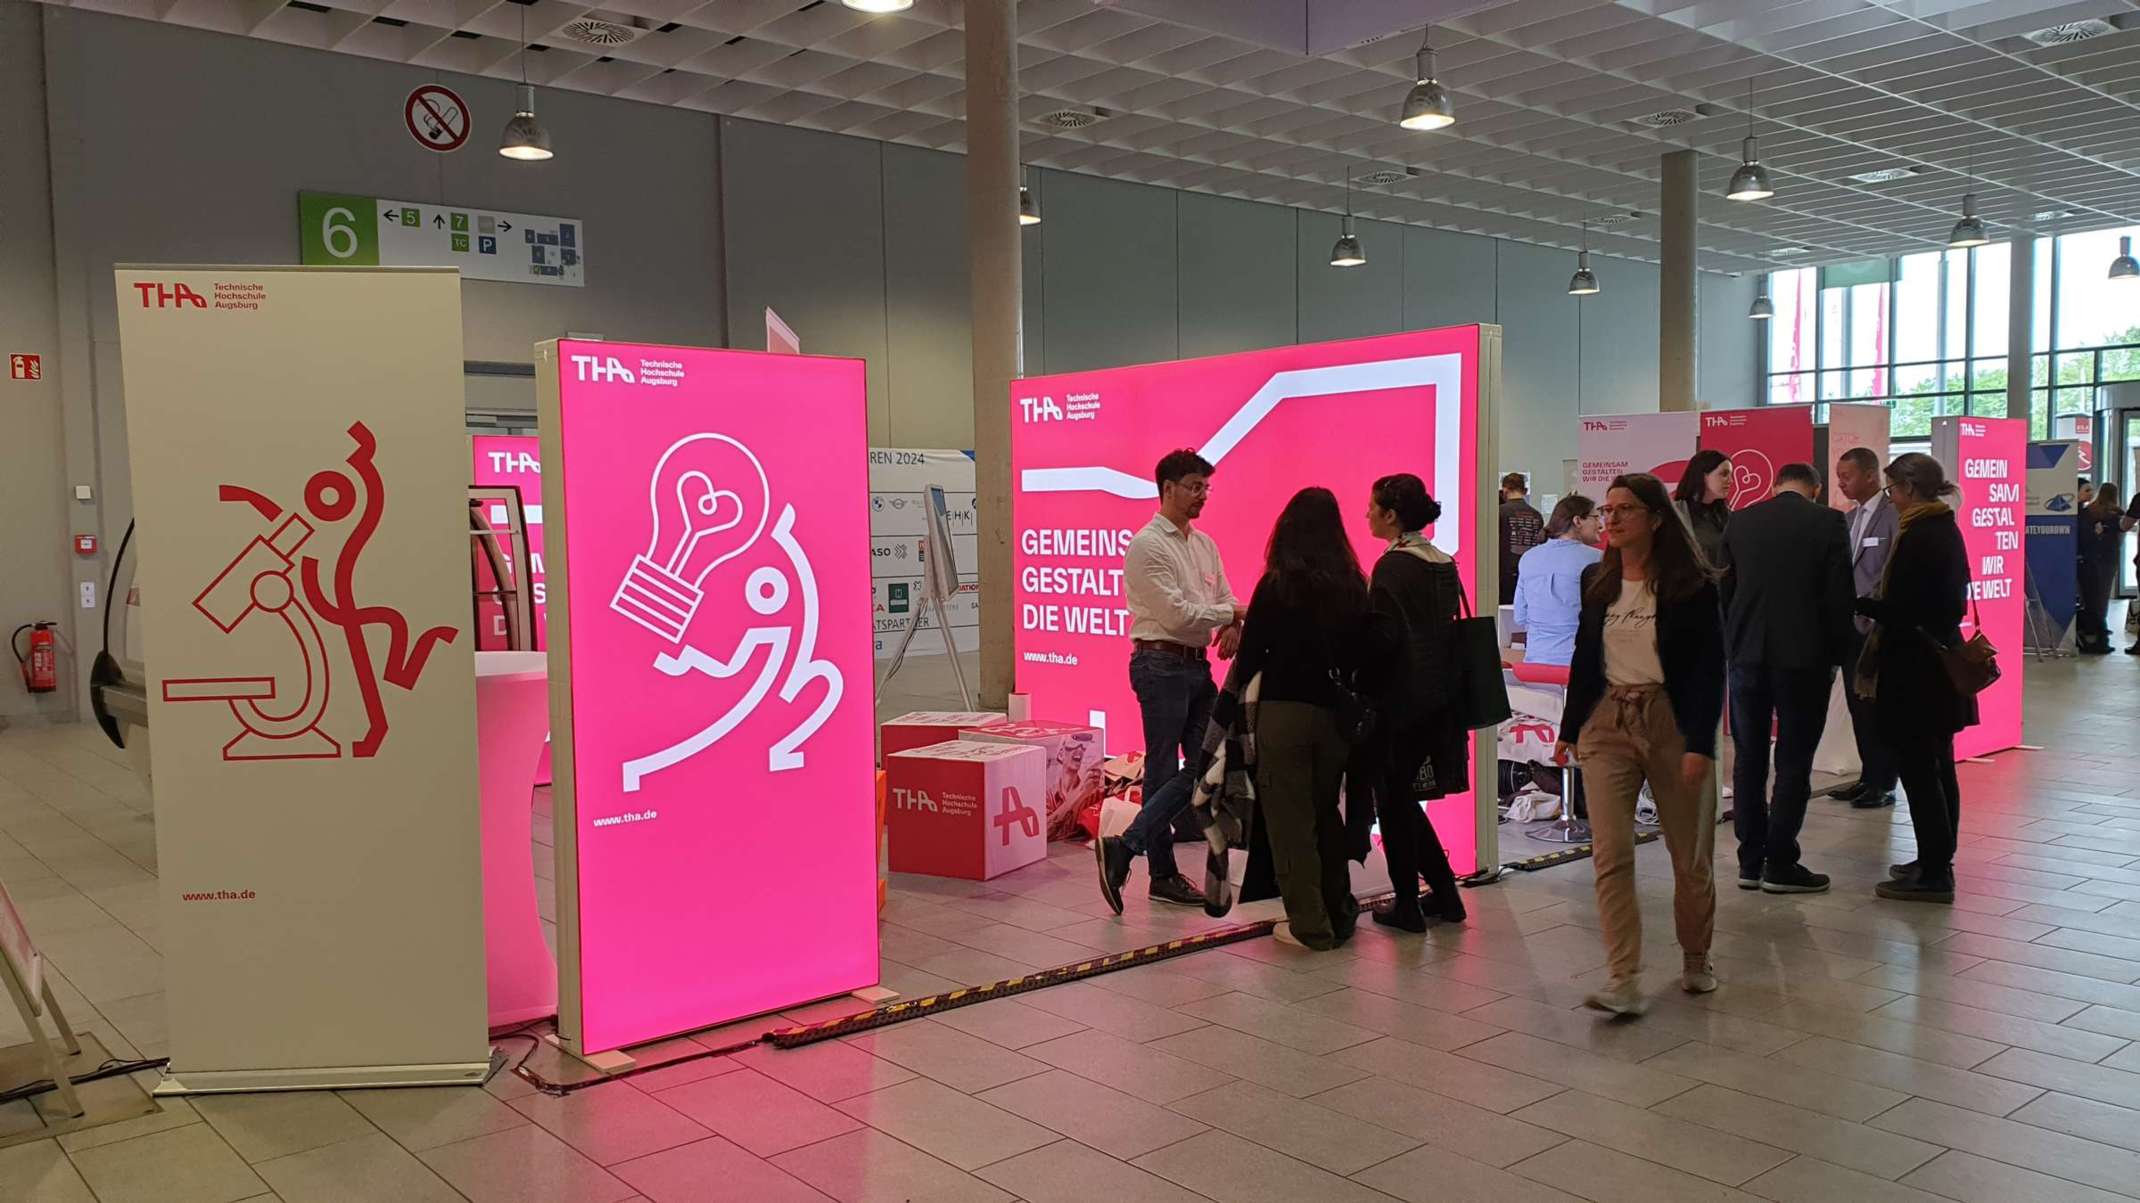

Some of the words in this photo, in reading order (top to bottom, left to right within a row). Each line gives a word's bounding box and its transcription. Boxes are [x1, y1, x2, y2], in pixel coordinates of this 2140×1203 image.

[406, 209, 416, 225] 5
[456, 215, 464, 229] 7
[322, 207, 358, 258] 6
[483, 238, 493, 252] P
[214, 283, 264, 291] Technische
[134, 283, 208, 308] THA
[214, 292, 267, 300] Hochschule
[214, 301, 259, 310] Augsburg
[571, 355, 635, 383] THA
[640, 359, 682, 368] Technische
[640, 368, 685, 377] Hochschule
[641, 377, 678, 387] Augsburg
[1020, 396, 1063, 424] THA
[896, 453, 925, 465] 2024
[1965, 459, 2007, 478] GEMEIN
[1989, 484, 2019, 502] SAM
[1972, 508, 2014, 527] GESTAL
[1996, 532, 2018, 550] TEN
[1982, 556, 2004, 575] WIR
[1022, 567, 1124, 596] GESTALT
[1983, 579, 2012, 599] WELT
[1023, 604, 1059, 632] DIE
[1063, 606, 1130, 636] WELT
[1023, 652, 1078, 665] www.tha.de
[942, 792, 976, 801] Technische
[942, 800, 977, 808] Hochschule
[593, 810, 657, 827] www.tha.de
[942, 807, 972, 816] Augsburg
[182, 889, 256, 901] www.tha.de
